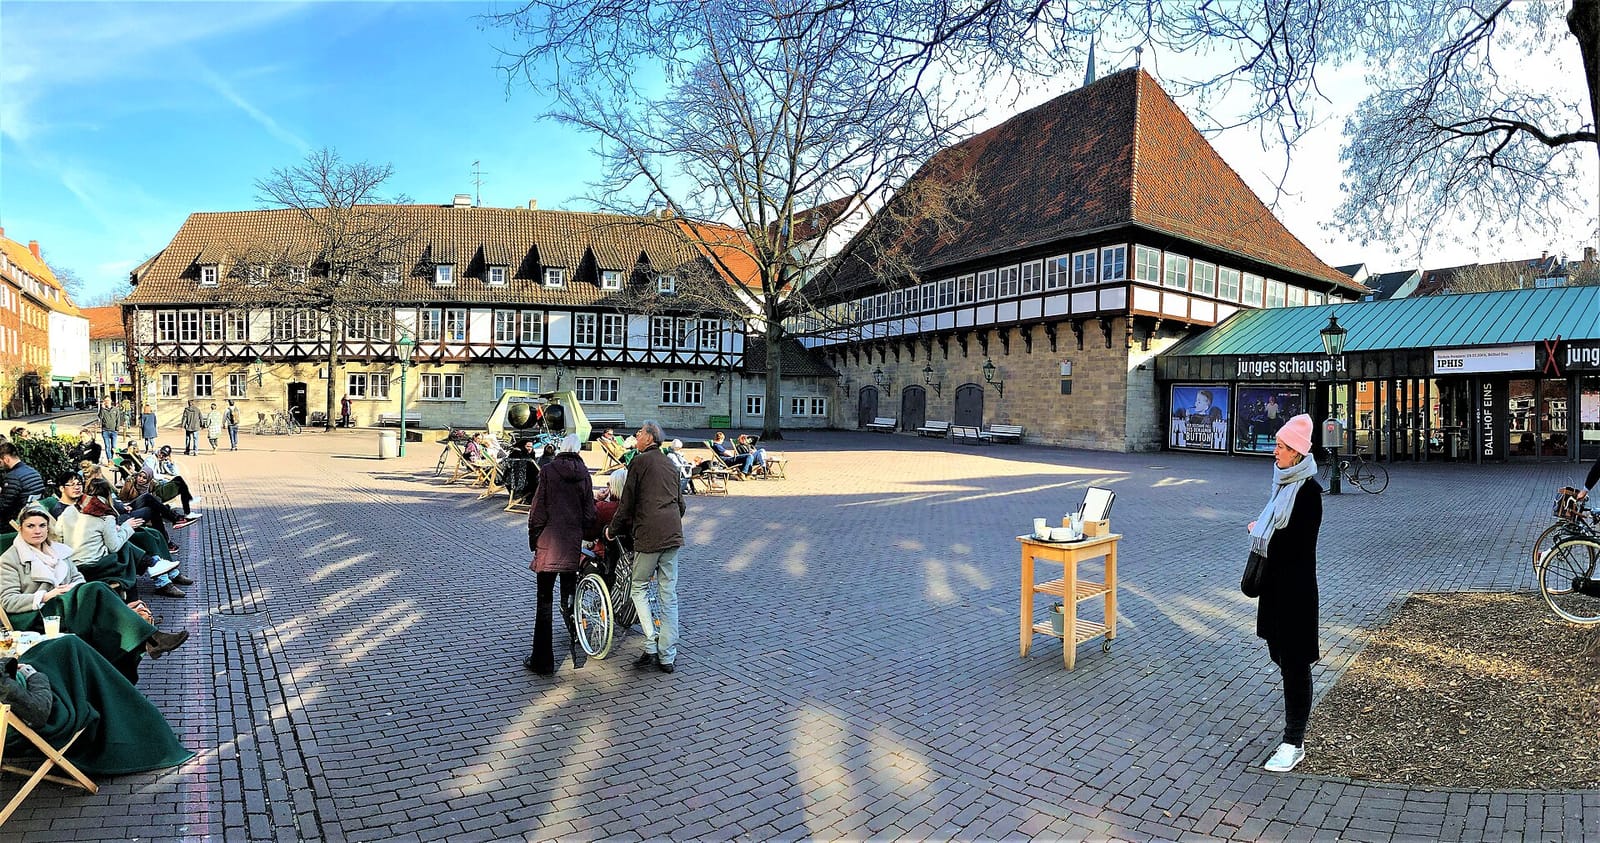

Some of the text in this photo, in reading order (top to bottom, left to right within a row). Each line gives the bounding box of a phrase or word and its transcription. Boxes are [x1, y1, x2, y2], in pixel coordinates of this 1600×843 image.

[1237, 357, 1277, 376] junges
[1437, 359, 1464, 368] IPHIS
[1483, 383, 1493, 456] BALLHOF EINS
[1185, 432, 1211, 442] BUTTON
